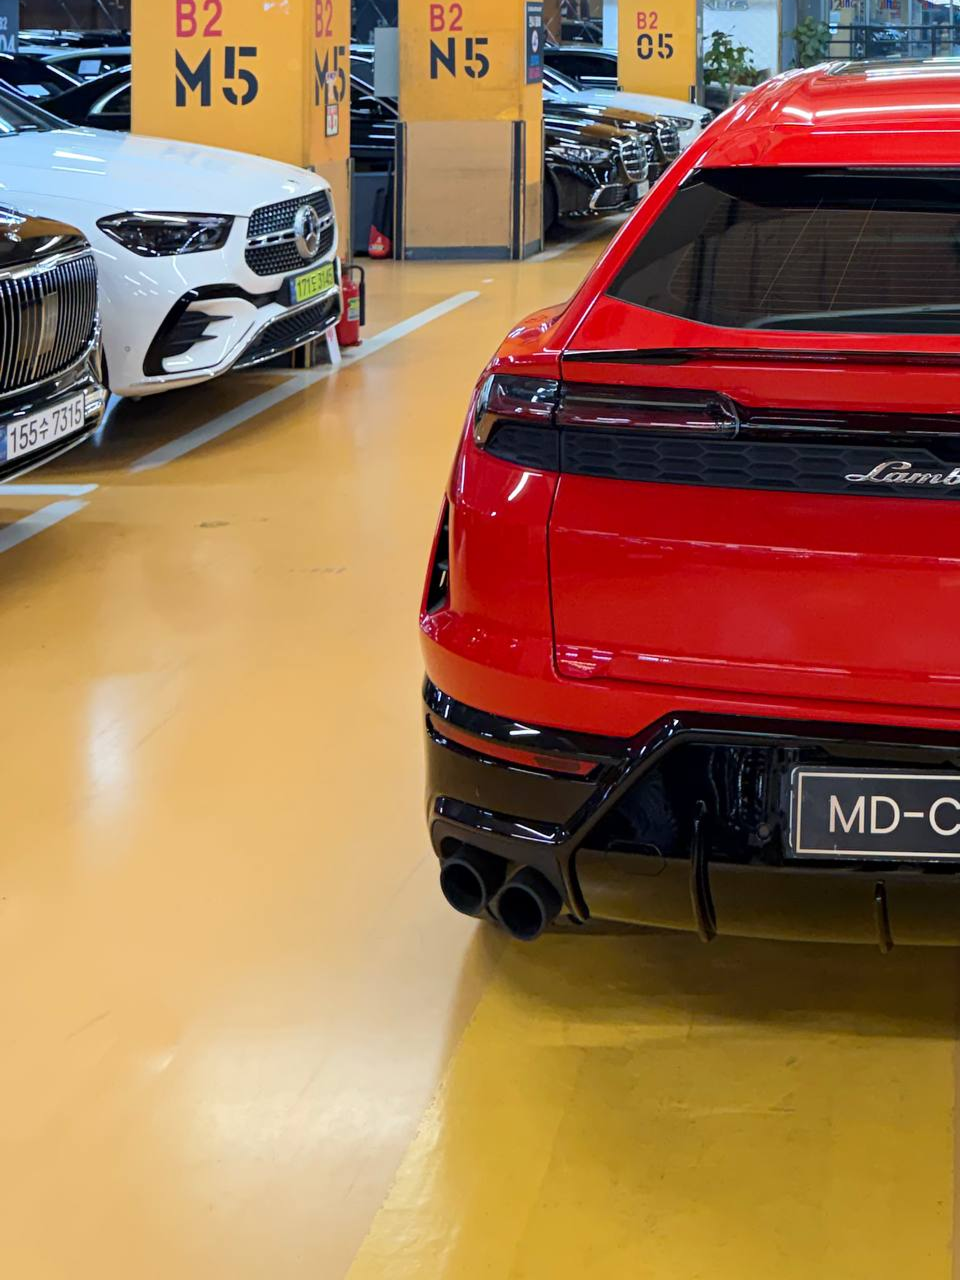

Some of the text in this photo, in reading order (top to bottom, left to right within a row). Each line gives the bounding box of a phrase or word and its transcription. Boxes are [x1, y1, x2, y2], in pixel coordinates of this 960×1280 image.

[430, 3, 463, 32] B2
[637, 11, 658, 30] B2
[175, 46, 258, 107] M5
[315, 46, 346, 106] M5
[430, 37, 489, 80] N5
[10, 399, 82, 453] 155수 7315
